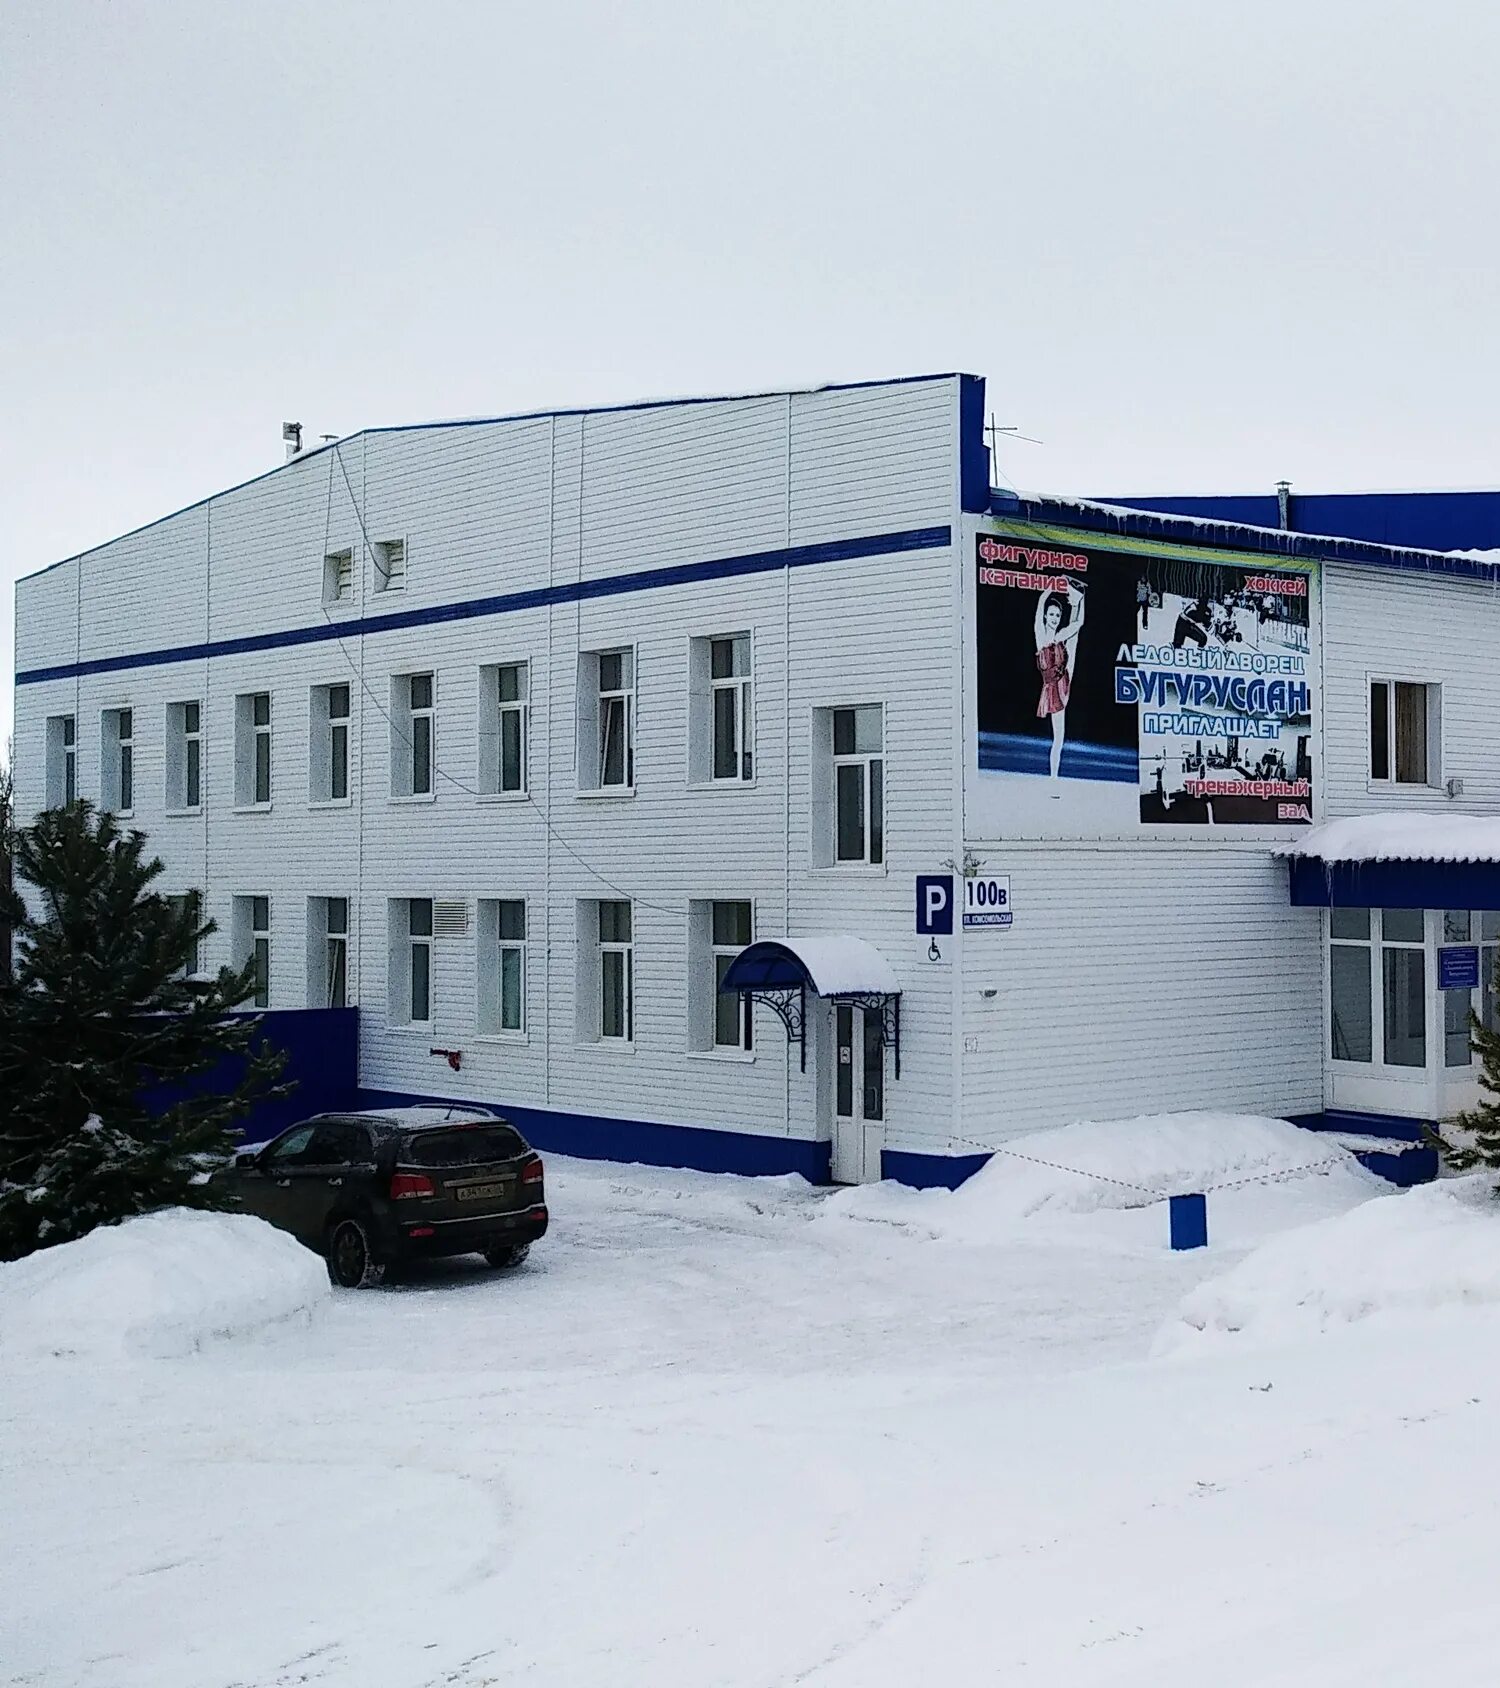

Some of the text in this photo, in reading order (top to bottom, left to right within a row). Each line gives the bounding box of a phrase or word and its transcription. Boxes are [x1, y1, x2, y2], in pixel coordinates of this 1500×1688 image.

[979, 539, 1088, 570] фигурное
[979, 568, 1068, 593] катание
[1244, 573, 1307, 596] хоккей
[1116, 643, 1306, 674] ЛЕДОВЫЙ ДВОРЕЦ
[1115, 668, 1308, 717] БУГУРУСЛАН
[1143, 713, 1283, 739] ПРИГЛАШАЕТ
[1186, 778, 1309, 799] тренажерный
[1278, 804, 1309, 820] зал
[925, 885, 947, 927] P
